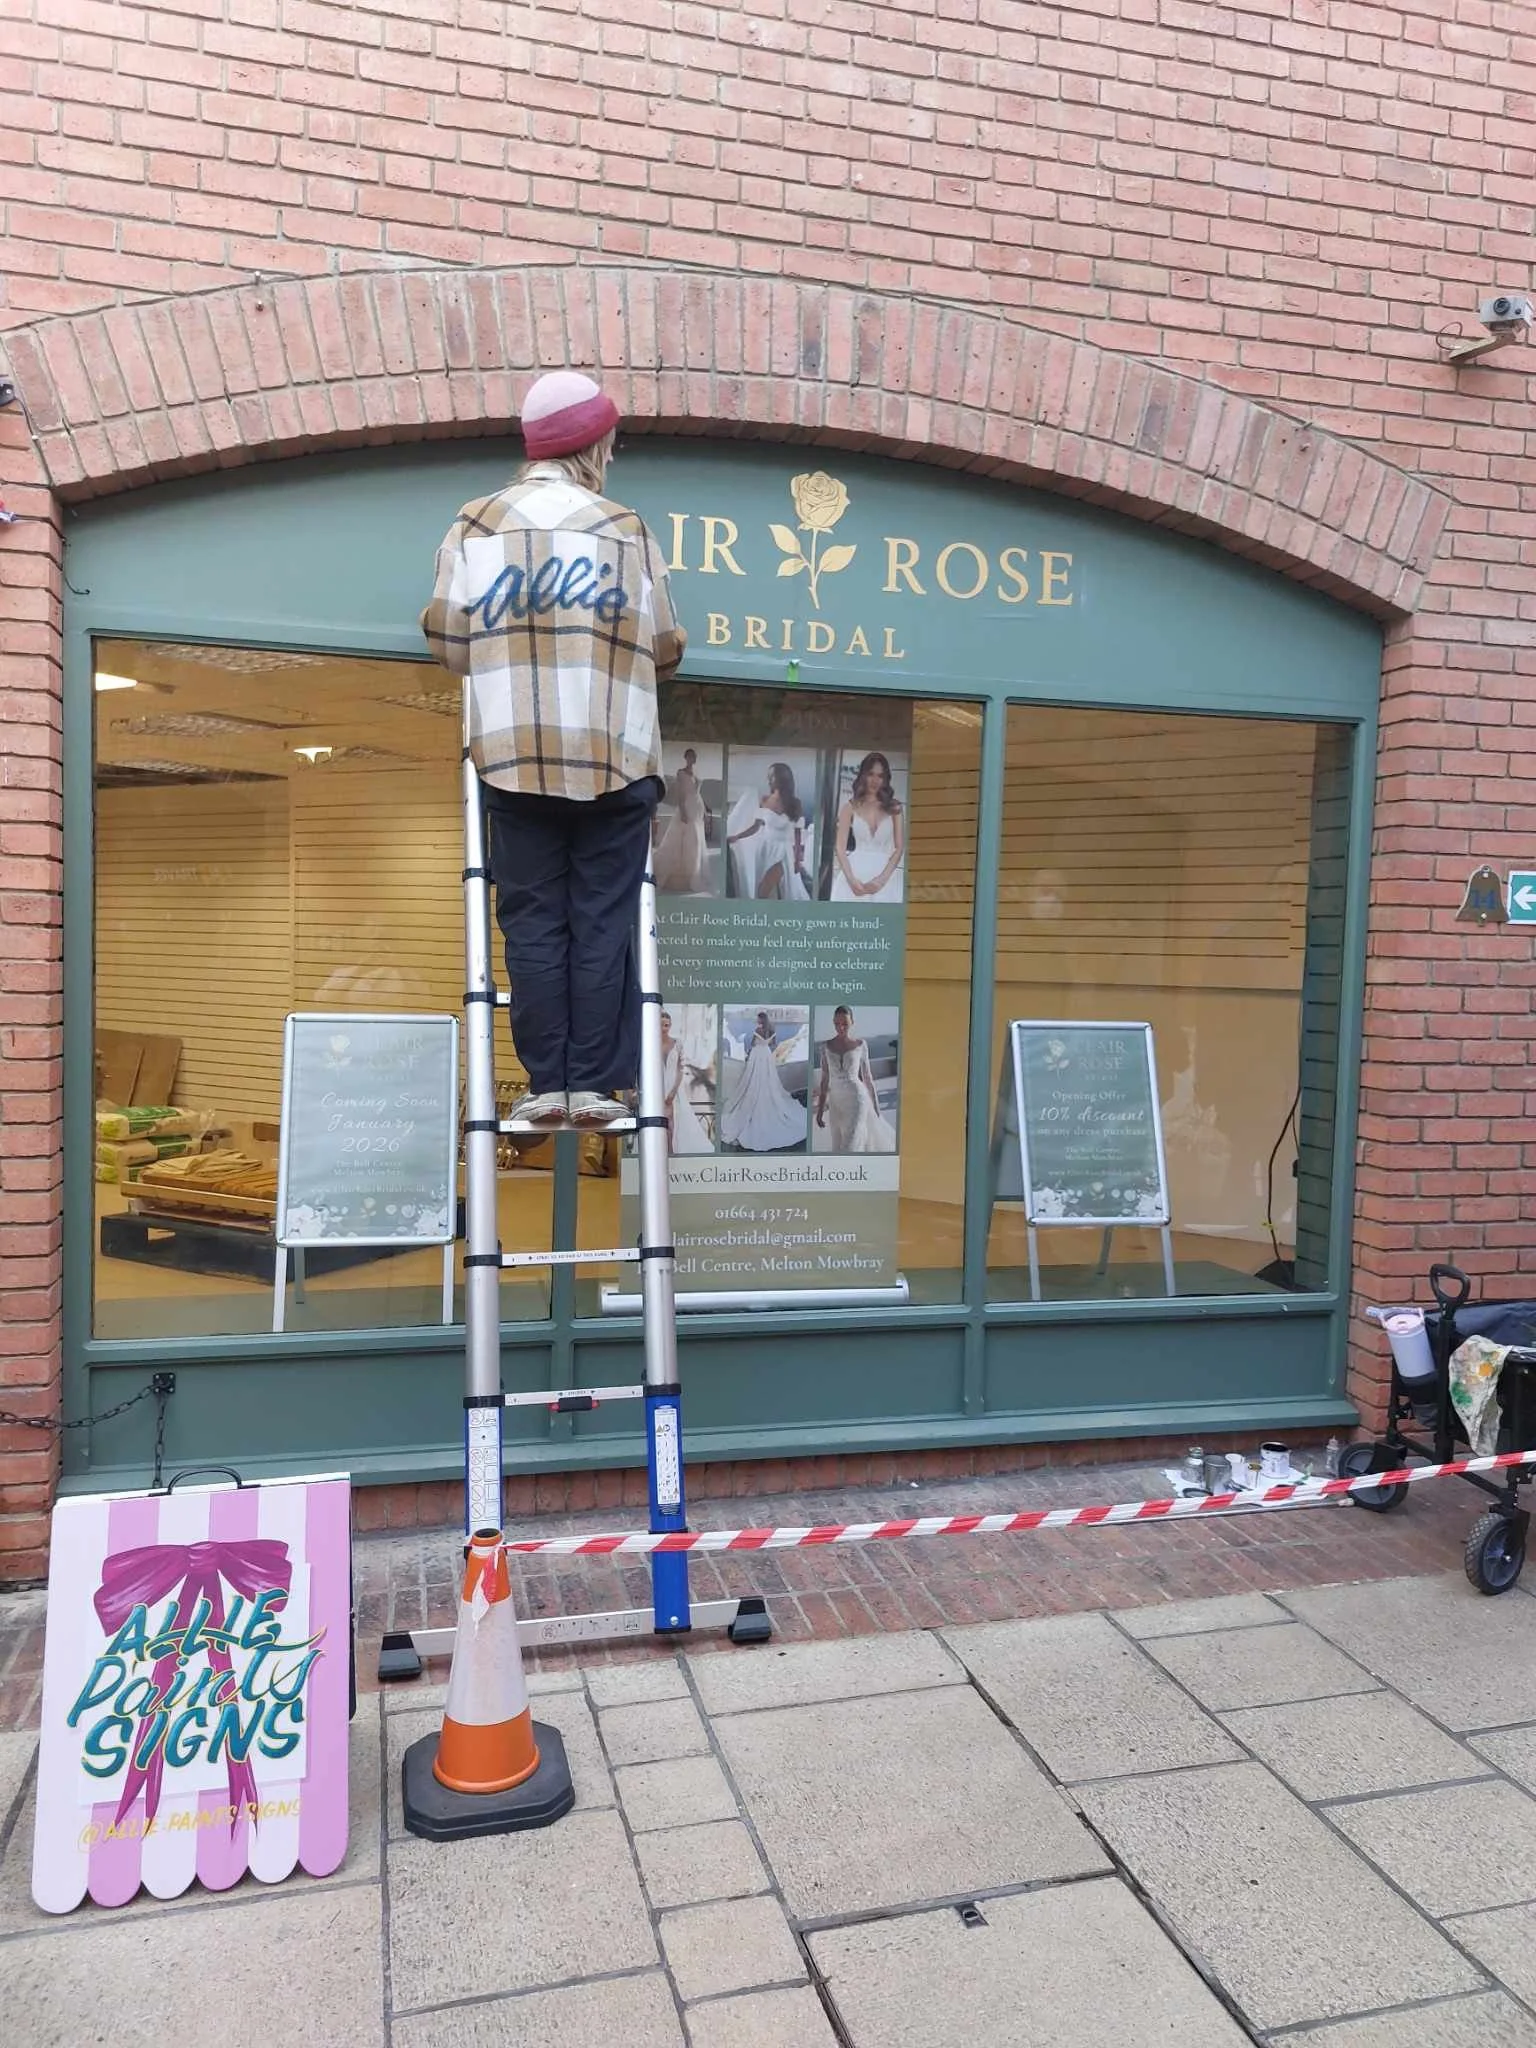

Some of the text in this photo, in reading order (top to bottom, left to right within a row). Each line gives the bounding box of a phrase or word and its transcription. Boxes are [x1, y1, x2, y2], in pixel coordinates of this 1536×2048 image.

[881, 537, 1074, 606] ROSE
[707, 612, 906, 659] BRIDAL
[670, 911, 700, 925] Clair
[703, 912, 729, 926] Rose
[733, 912, 771, 927] Bridal,
[774, 918, 803, 931] every
[806, 918, 836, 931] gown
[840, 917, 849, 929] is
[852, 916, 885, 929] hand-
[657, 933, 892, 953] ected to make you feel truly unforgettable
[658, 953, 885, 973] nd every moment is designed to celebrate
[667, 975, 866, 994] the love story you're about to begin.
[319, 1091, 441, 1115] Coming Soon
[1051, 1089, 1097, 1103] Opening
[1039, 1105, 1145, 1123] 10% discount
[327, 1113, 417, 1138] January
[340, 1136, 401, 1153] 2026
[670, 1164, 868, 1183] ww.ClairRoseBridal.co.uk
[715, 1205, 809, 1222] 01664 431 724
[672, 1228, 857, 1249] lairrosebridal@gmail.com
[702, 1258, 757, 1274] Centre,
[761, 1254, 813, 1271] Melton
[817, 1252, 885, 1273] Mowbray
[104, 1587, 328, 1662] ALLIE
[66, 1644, 325, 1728] Paints
[81, 1697, 306, 1779] SIGNS
